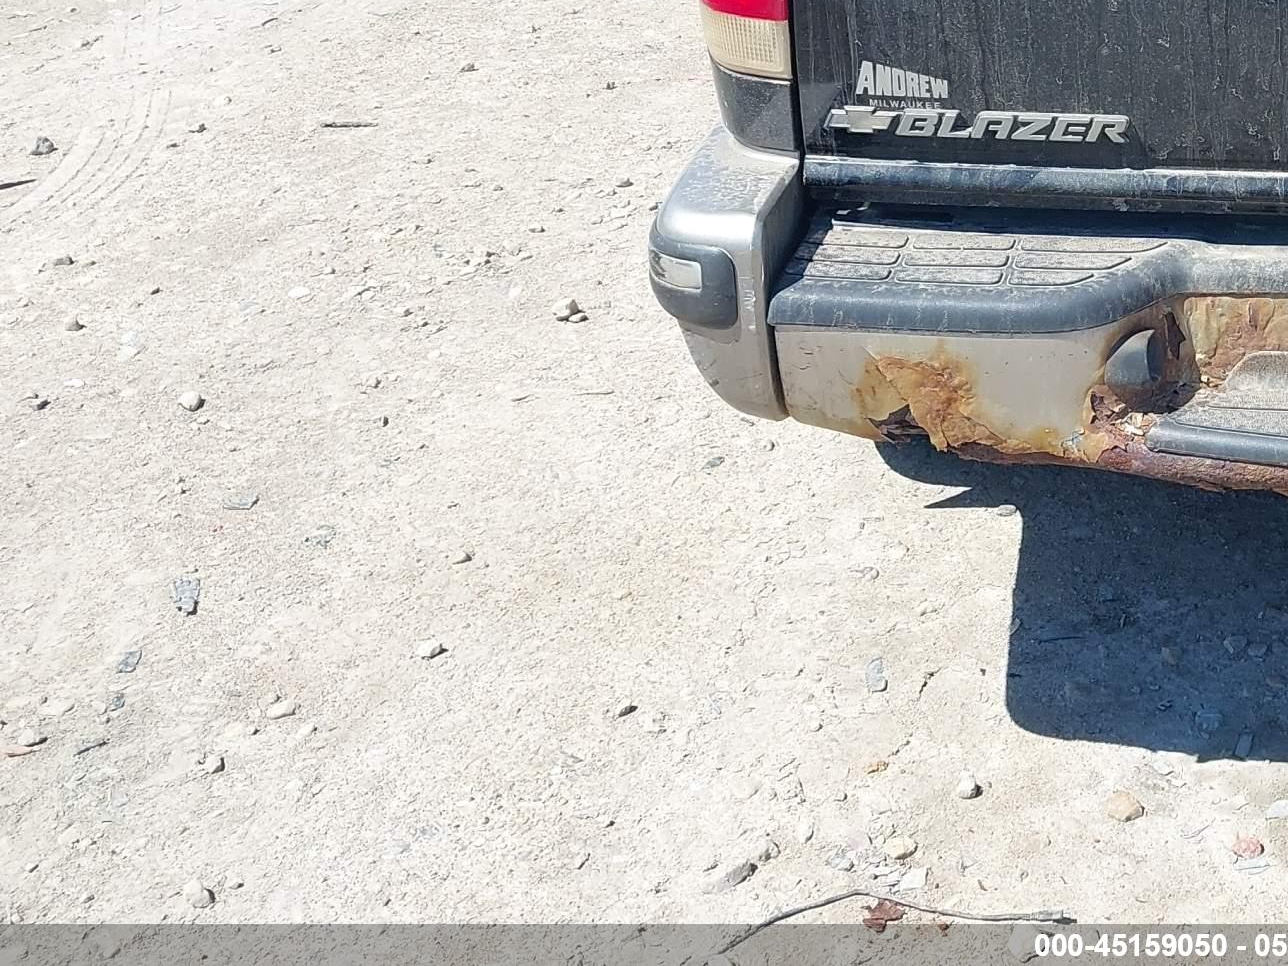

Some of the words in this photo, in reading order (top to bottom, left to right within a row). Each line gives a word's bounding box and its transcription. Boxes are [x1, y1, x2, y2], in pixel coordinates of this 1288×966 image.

[856, 60, 949, 99] ANDREW
[869, 98, 941, 109] MILWAUKEE
[895, 108, 1130, 143] BLAZER
